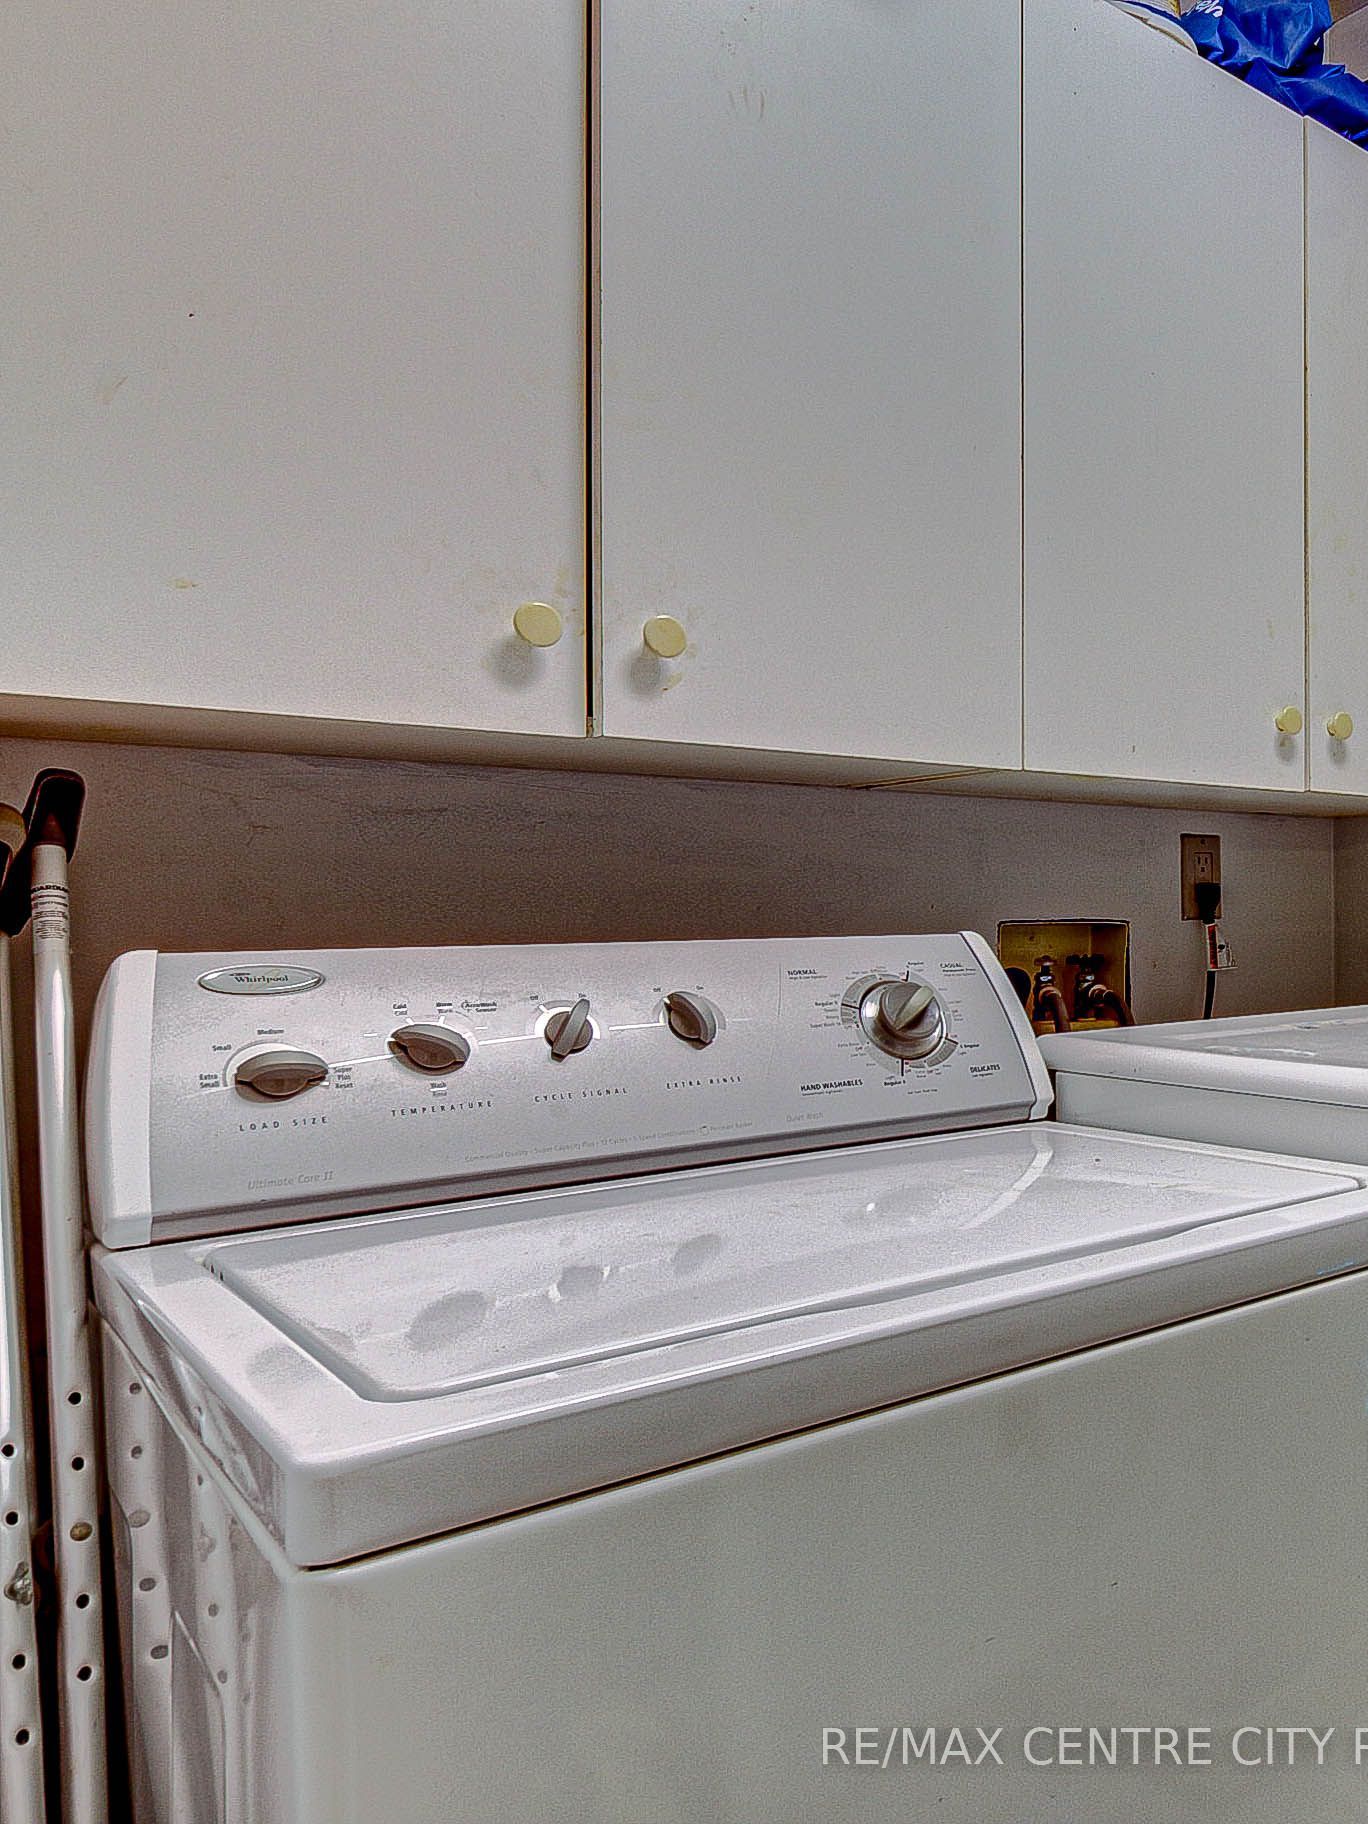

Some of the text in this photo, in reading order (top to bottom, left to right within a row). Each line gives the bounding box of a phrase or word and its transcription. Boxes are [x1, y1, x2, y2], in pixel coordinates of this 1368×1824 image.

[234, 974, 289, 984] Whirlpool
[970, 1064, 1000, 1073] DELICATES
[199, 1073, 218, 1081] Extra
[666, 1076, 741, 1090] EXTRA RINSE
[200, 1081, 220, 1089] Small
[801, 1079, 863, 1091] HAND WASHABLES
[535, 1087, 627, 1103] CYCLE SIGNAL
[391, 1100, 493, 1117] TEMPERATURE
[240, 1116, 328, 1131] LOAD SIZE
[247, 1176, 294, 1190] Ultimate
